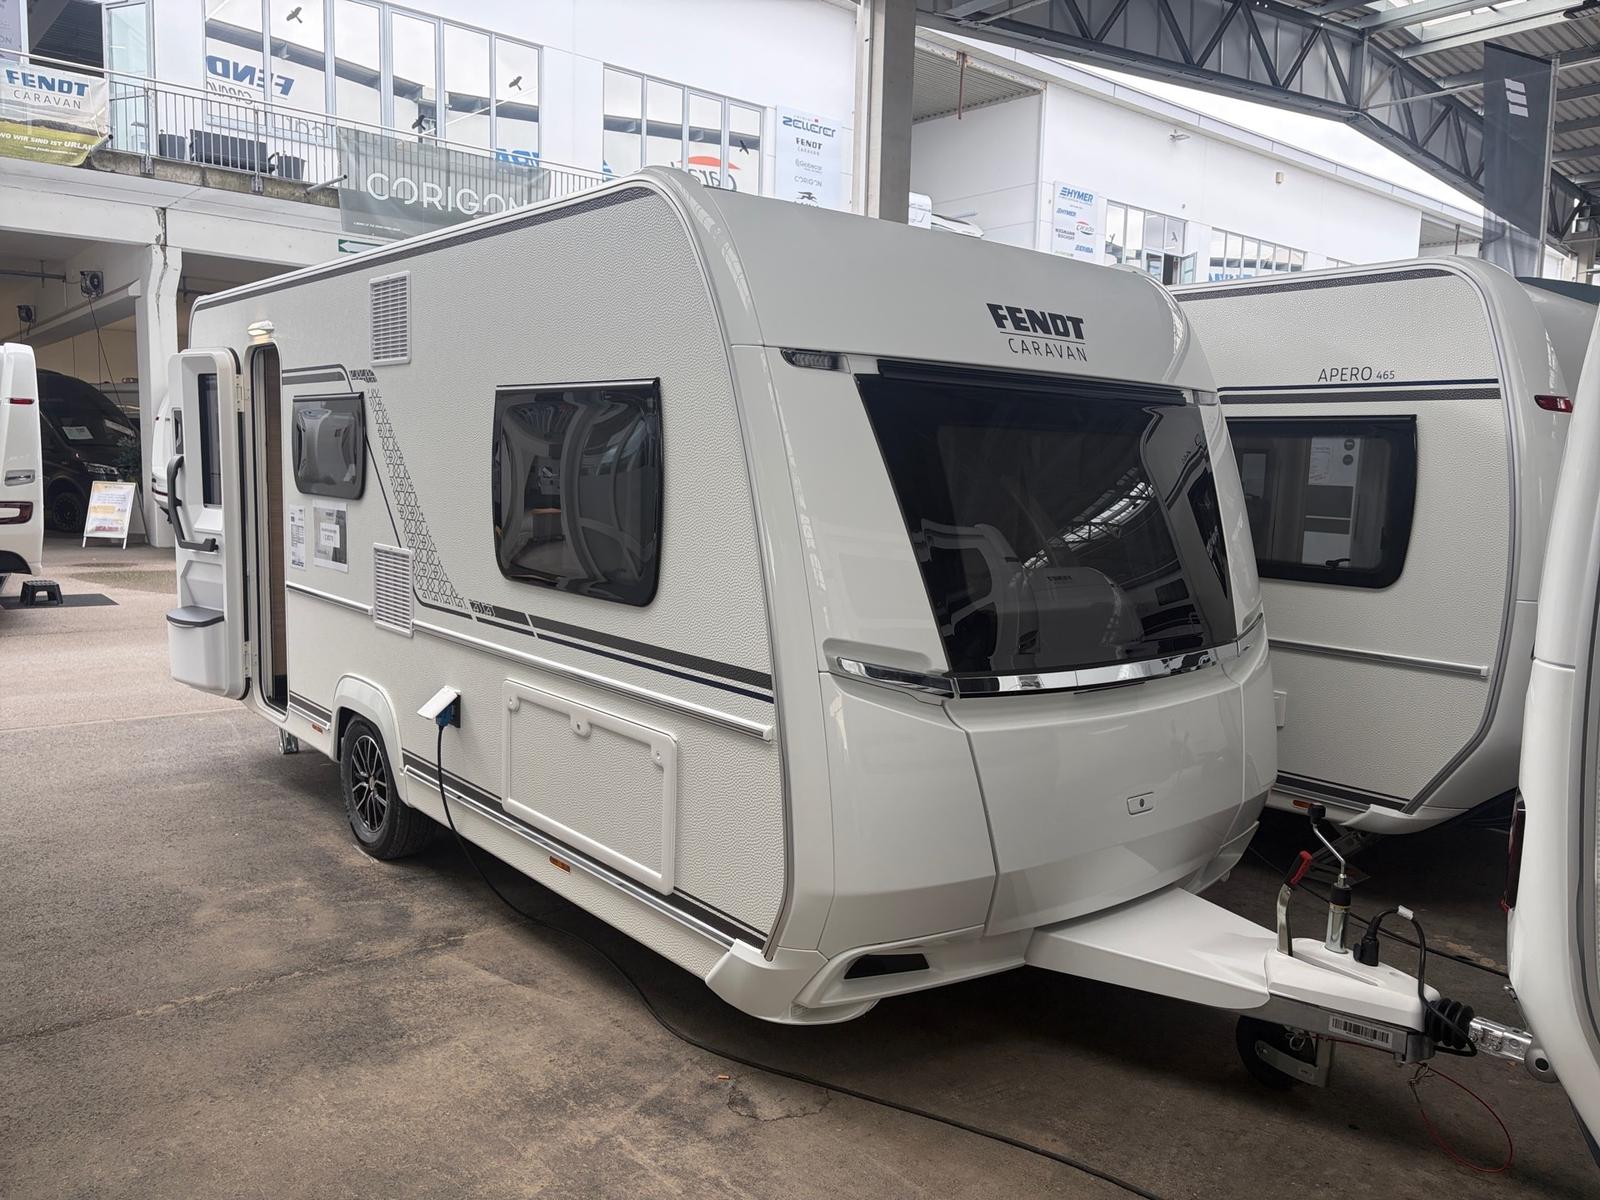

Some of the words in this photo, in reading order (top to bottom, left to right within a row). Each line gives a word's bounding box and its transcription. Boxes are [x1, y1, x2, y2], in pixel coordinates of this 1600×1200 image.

[5, 69, 89, 97] FENDT
[13, 89, 81, 110] CARAVAN
[13, 133, 29, 142] WIR
[30, 136, 49, 145] SIND
[796, 137, 823, 150] FENDT
[1066, 188, 1094, 203] HYMER
[986, 303, 1084, 340] FENDT
[1008, 338, 1088, 362] CARAVAN
[1318, 366, 1373, 382] APERO
[1376, 370, 1395, 380] 465
